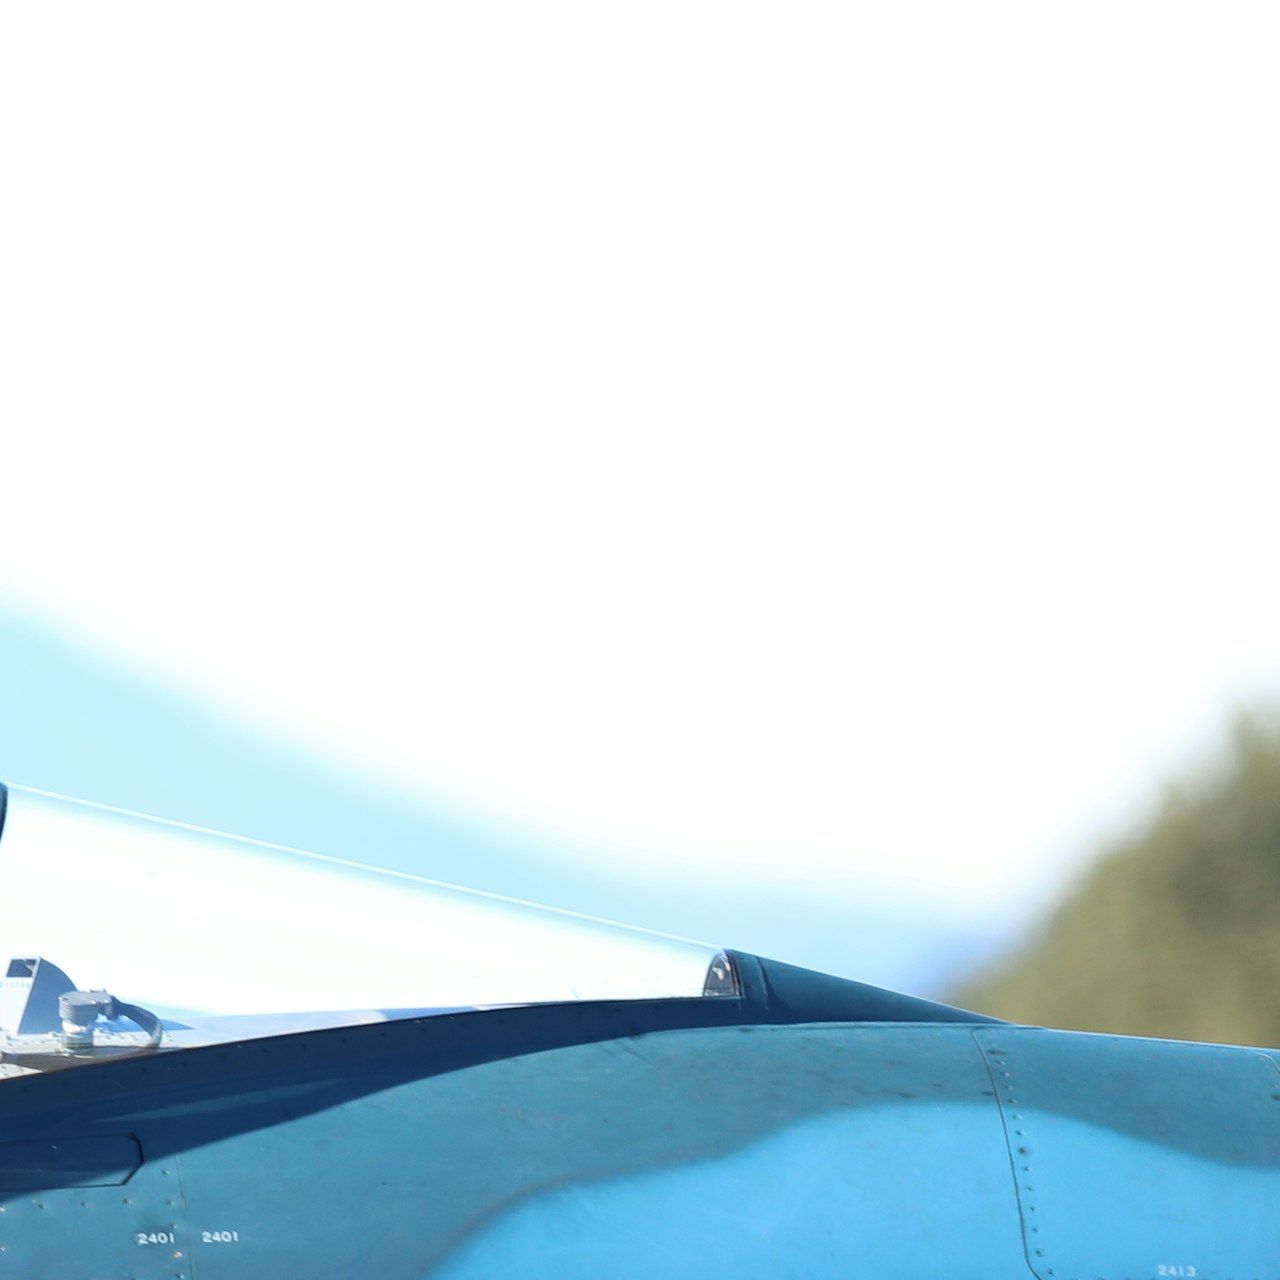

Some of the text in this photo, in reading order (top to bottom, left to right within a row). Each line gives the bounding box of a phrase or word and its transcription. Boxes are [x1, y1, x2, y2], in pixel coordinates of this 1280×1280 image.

[137, 1232, 175, 1245] 2401
[201, 1230, 239, 1243] 2401
[1158, 1264, 1197, 1277] 2413
